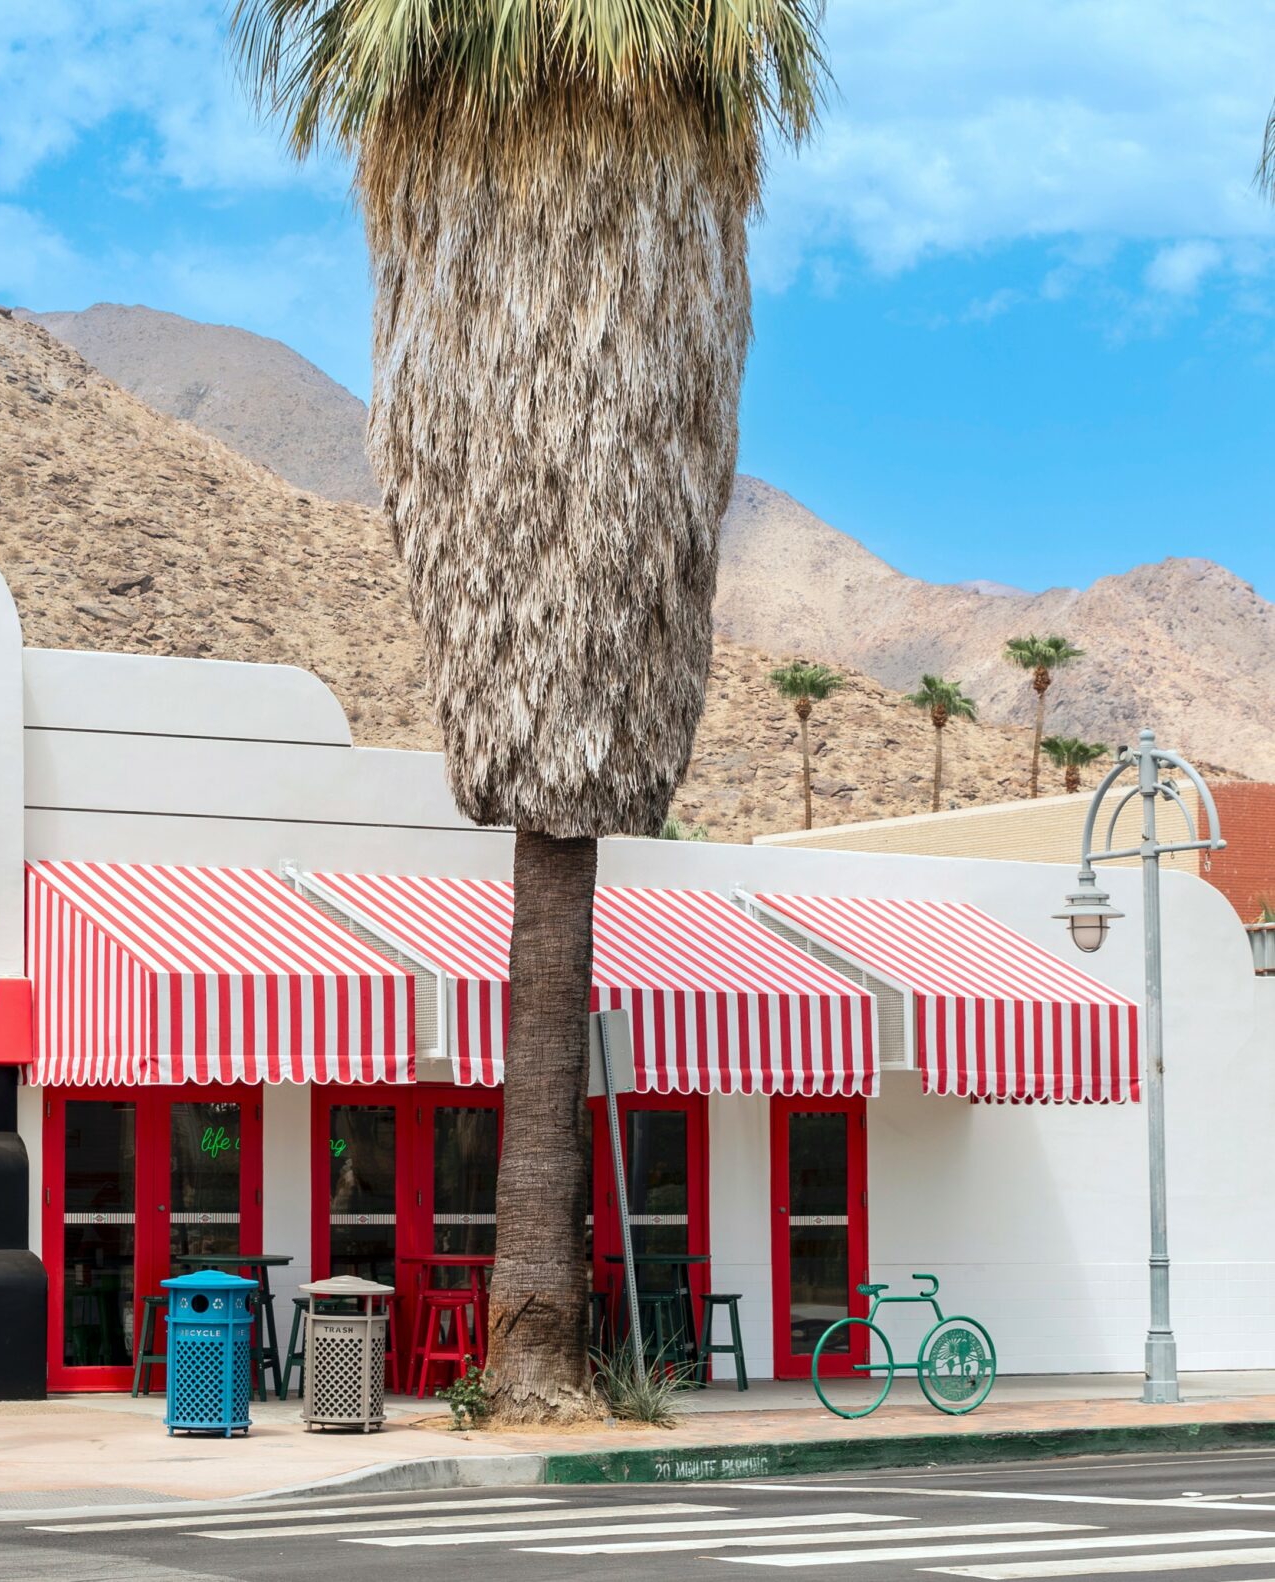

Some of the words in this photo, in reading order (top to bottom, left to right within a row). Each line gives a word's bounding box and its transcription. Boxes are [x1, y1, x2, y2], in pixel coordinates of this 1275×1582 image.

[200, 1127, 231, 1158] life
[324, 1326, 354, 1334] TRASH
[655, 1463, 671, 1480] 20
[675, 1460, 717, 1479] MINUTE
[721, 1457, 768, 1477] PARKING
